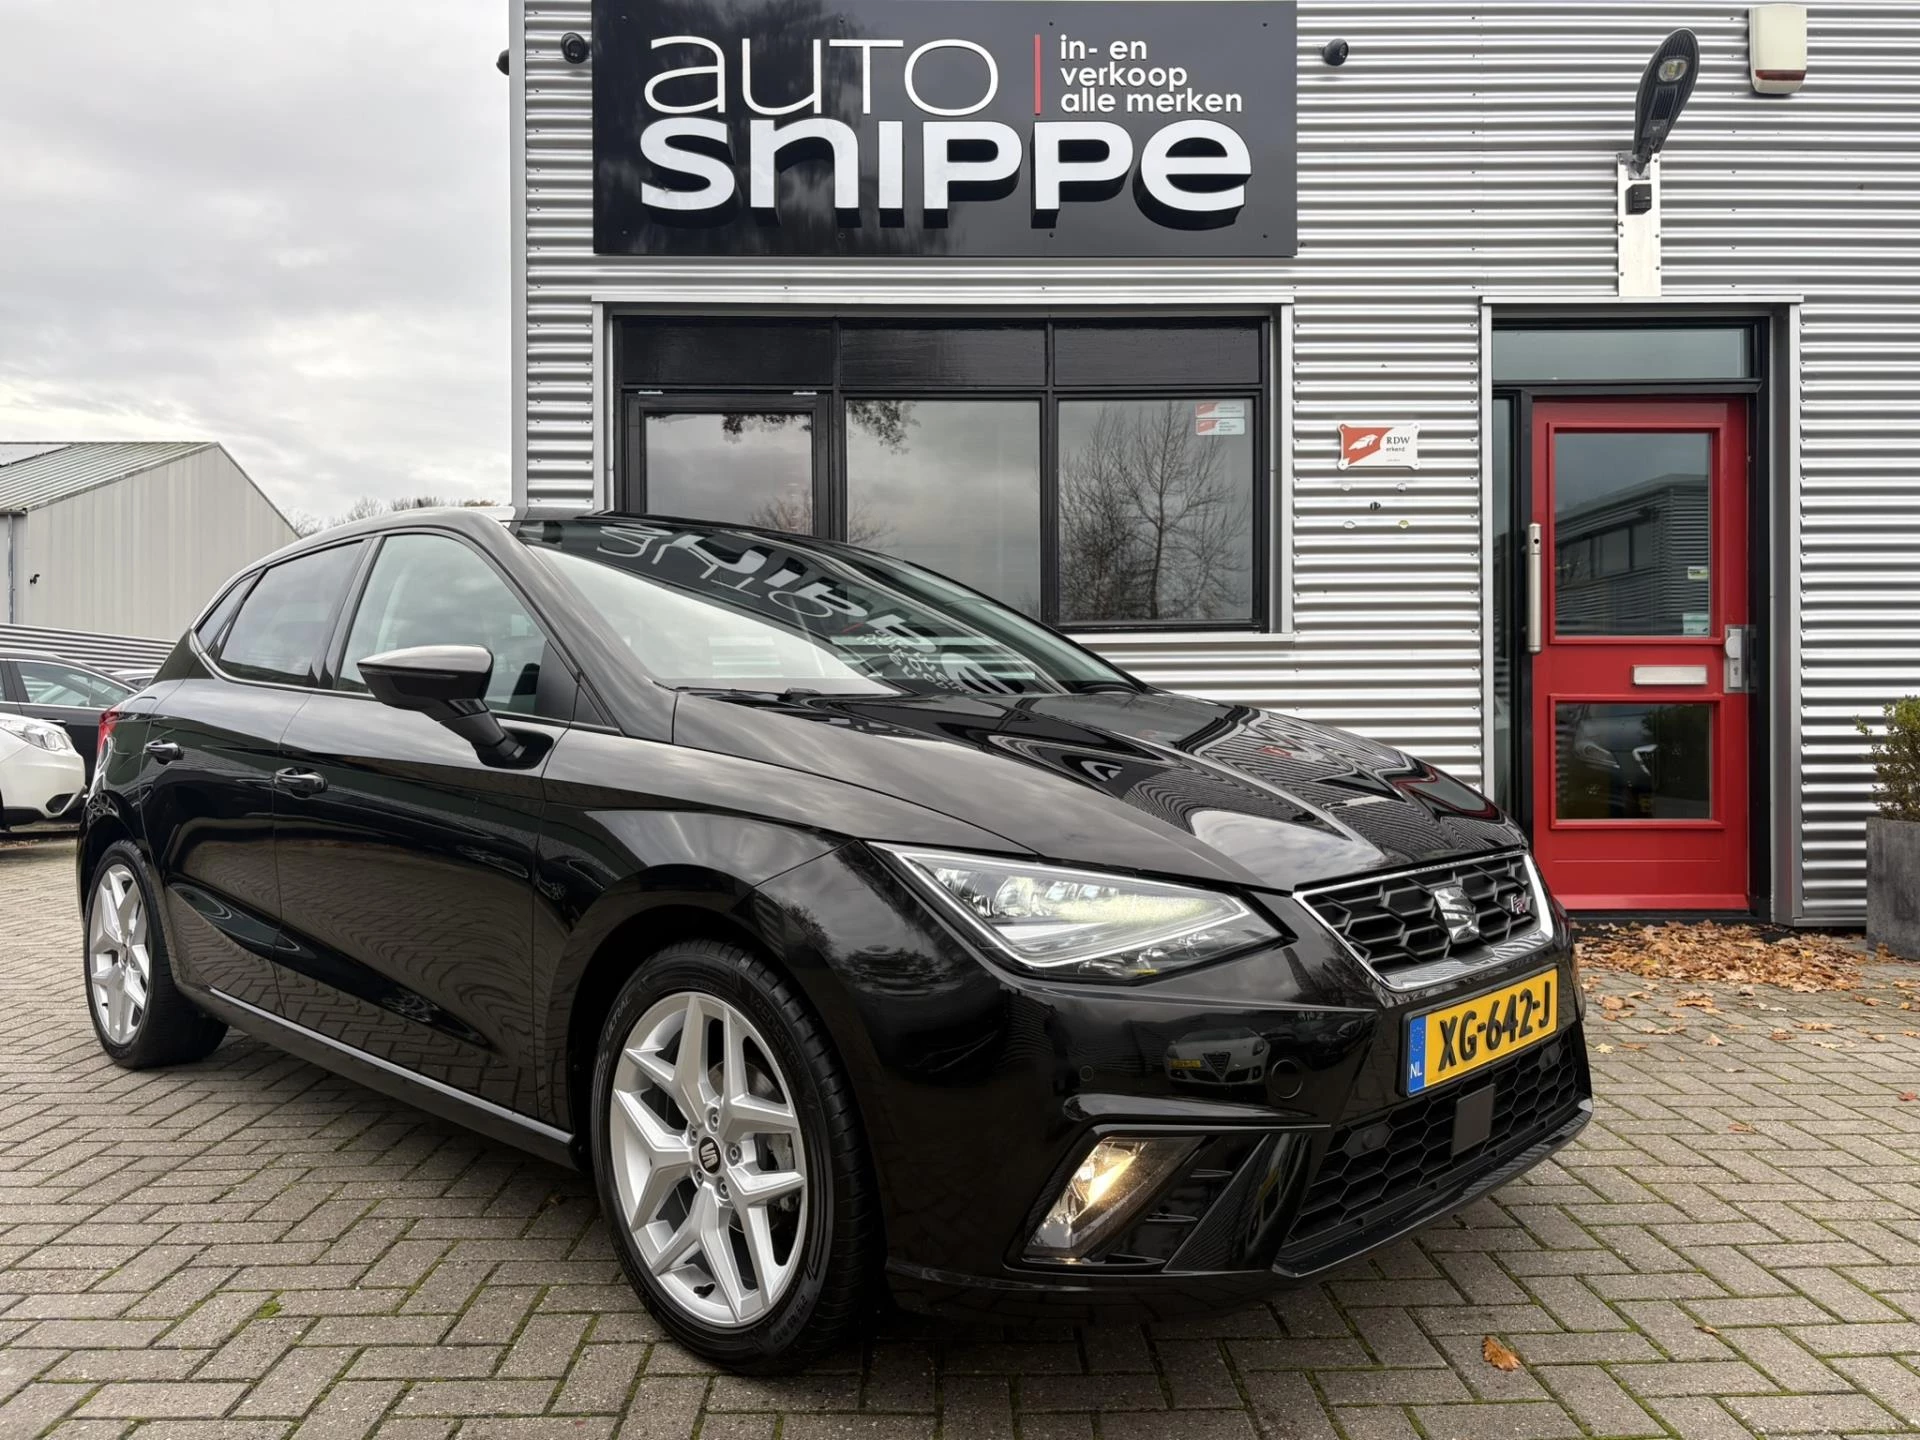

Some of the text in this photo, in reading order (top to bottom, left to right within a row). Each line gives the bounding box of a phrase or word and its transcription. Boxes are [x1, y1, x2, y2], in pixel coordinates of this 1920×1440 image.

[1060, 34, 1148, 60] in- en
[1060, 61, 1188, 92] verkoop
[1060, 87, 1243, 112] alle merken
[1386, 436, 1410, 445] RDW
[1437, 980, 1551, 1072] XG-642-J
[1410, 1061, 1423, 1080] NL
